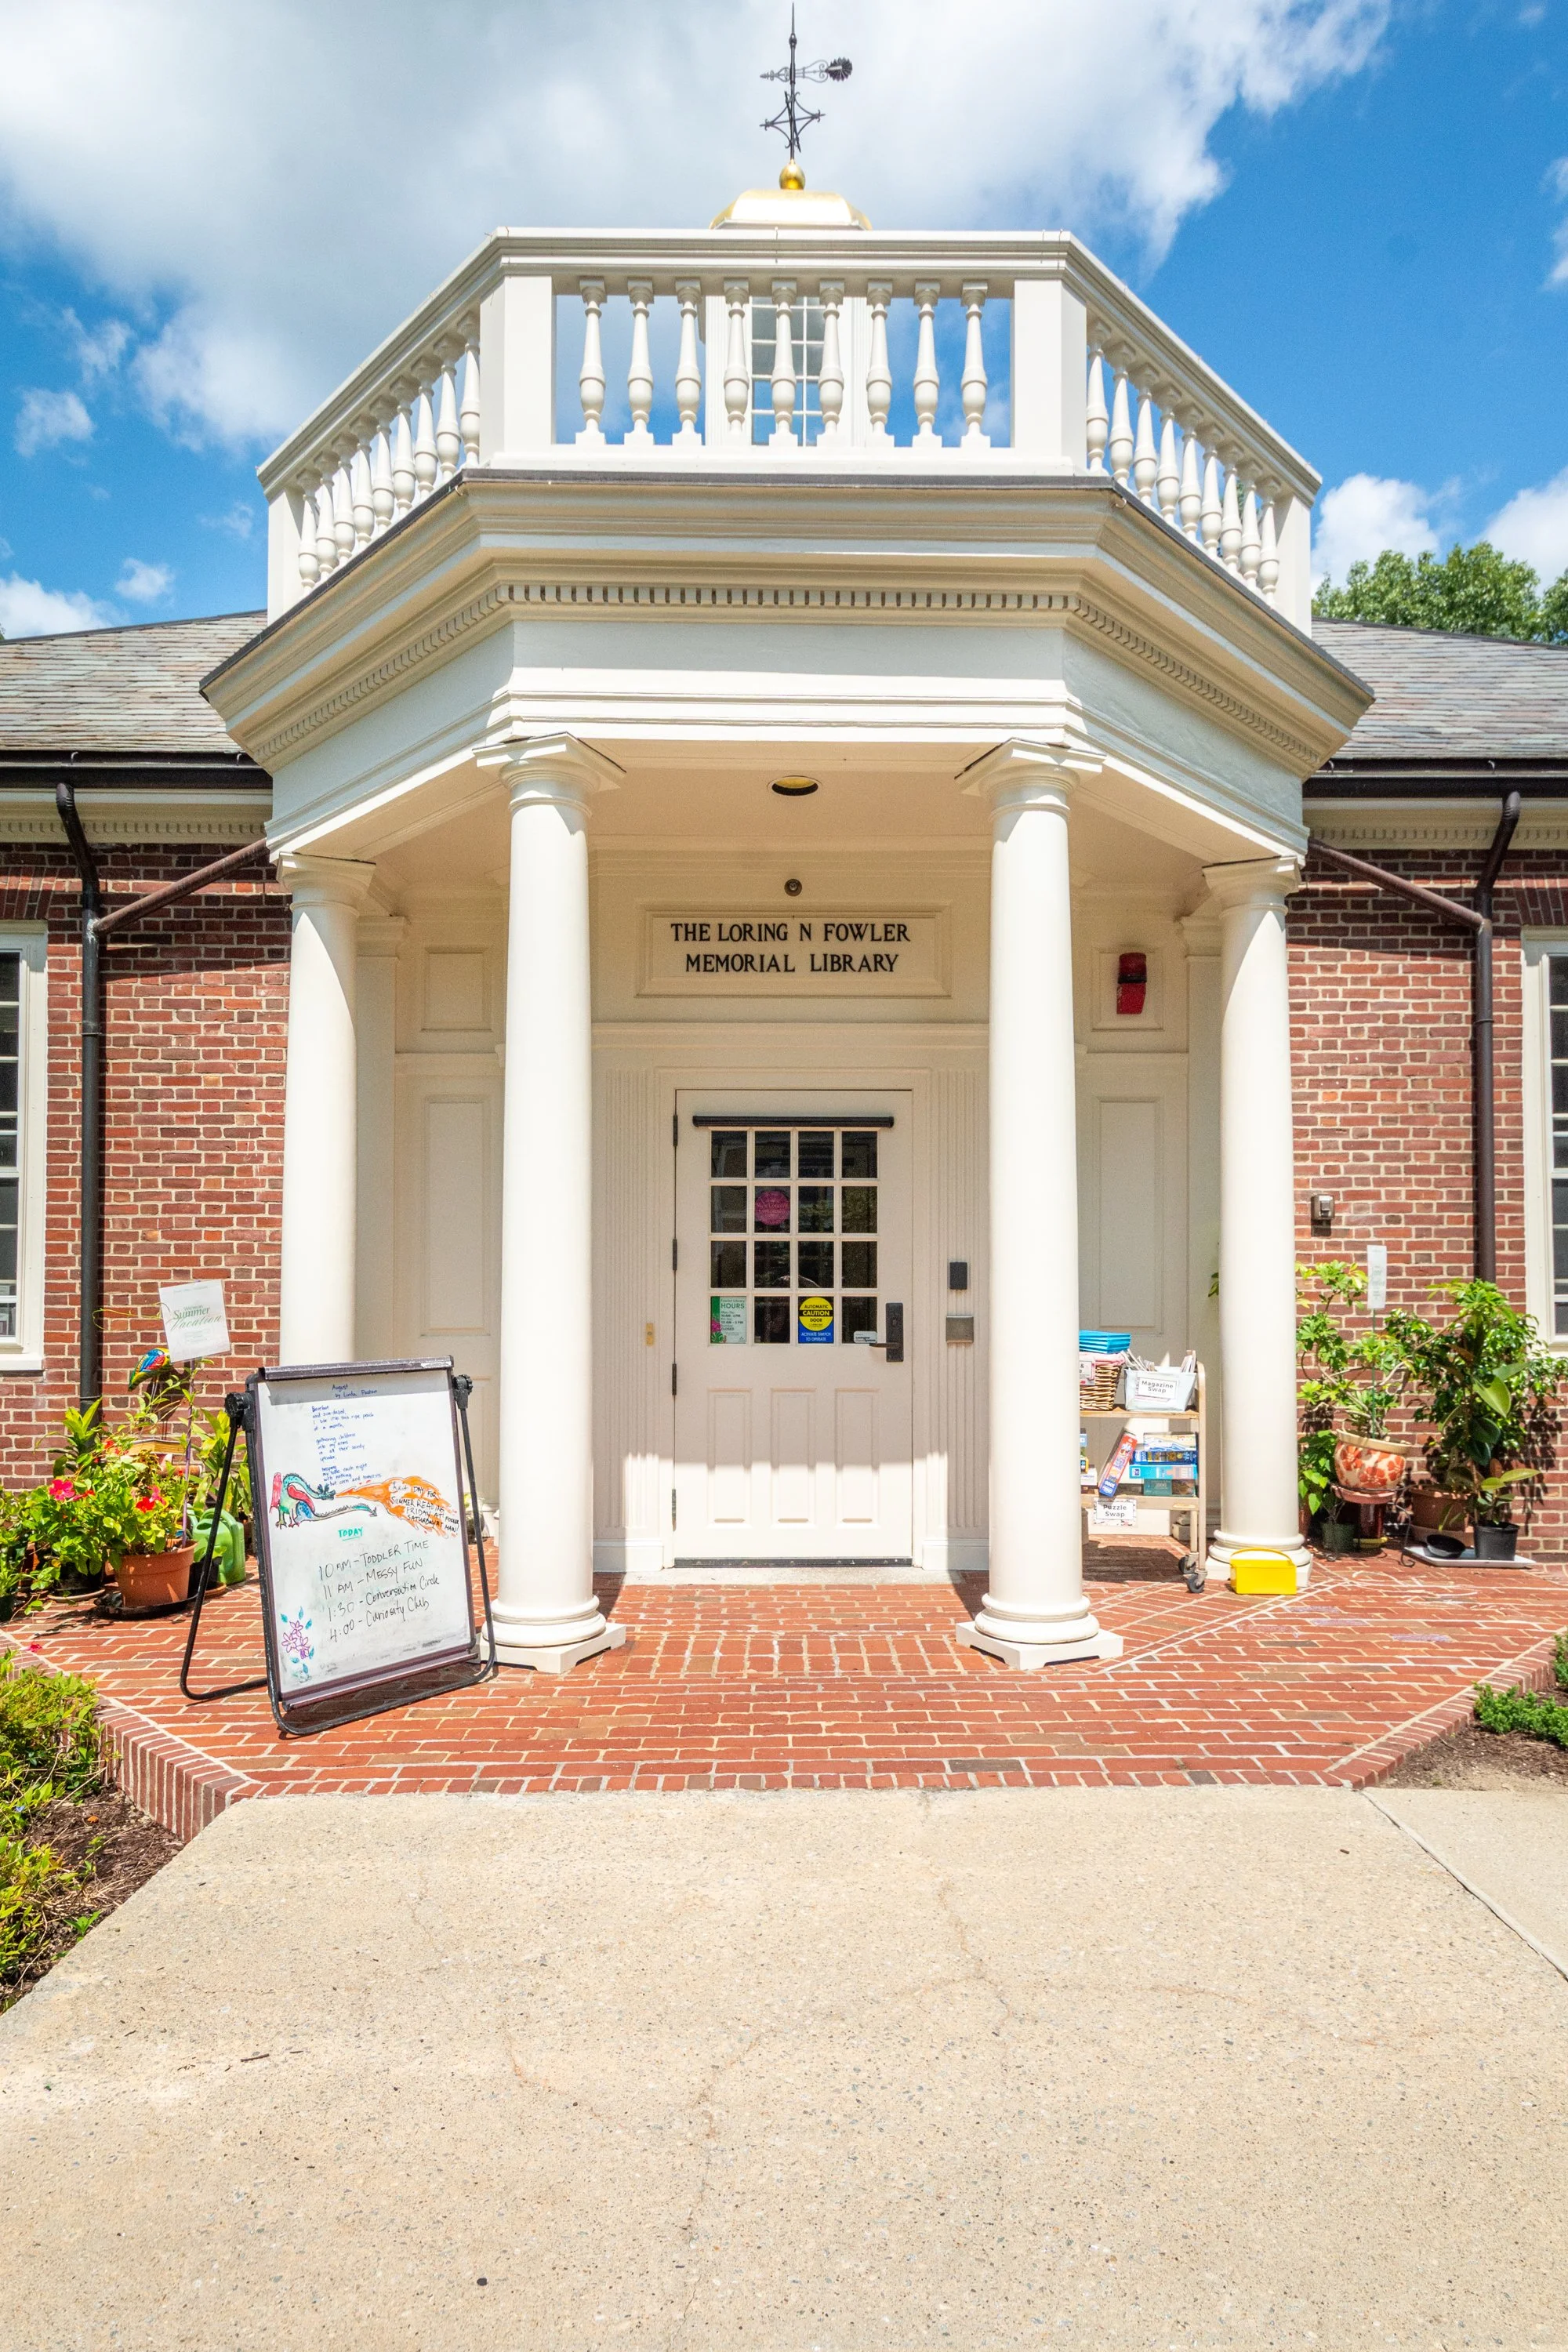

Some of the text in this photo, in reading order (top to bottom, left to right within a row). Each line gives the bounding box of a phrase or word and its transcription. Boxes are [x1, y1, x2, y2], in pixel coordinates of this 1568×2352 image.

[671, 923, 911, 942] THE LORING N FOWLER
[686, 953, 899, 973] MEMORIAL LIBRARY
[173, 1306, 210, 1319] Summer
[167, 1316, 222, 1331] Vacation
[332, 1384, 349, 1392] August
[1141, 1380, 1174, 1389] Magazine
[427, 1490, 439, 1500] FOR
[391, 1496, 445, 1512] SUMMER READING
[406, 1505, 431, 1516] FRIDAY
[407, 1514, 436, 1528] SATURDAY
[338, 1526, 364, 1538] TODAY
[359, 1544, 402, 1567] TODDLER
[404, 1539, 430, 1553] TIME
[323, 1584, 332, 1600] 11
[337, 1581, 354, 1593] AM
[365, 1566, 399, 1584] MESSY
[402, 1557, 424, 1573] FUN
[328, 1601, 354, 1622] 1:30
[365, 1582, 417, 1606] Conversation
[419, 1573, 441, 1590] Circle
[330, 1619, 354, 1642] 4:00
[366, 1599, 406, 1627] Curiosity
[405, 1596, 429, 1613] Club
